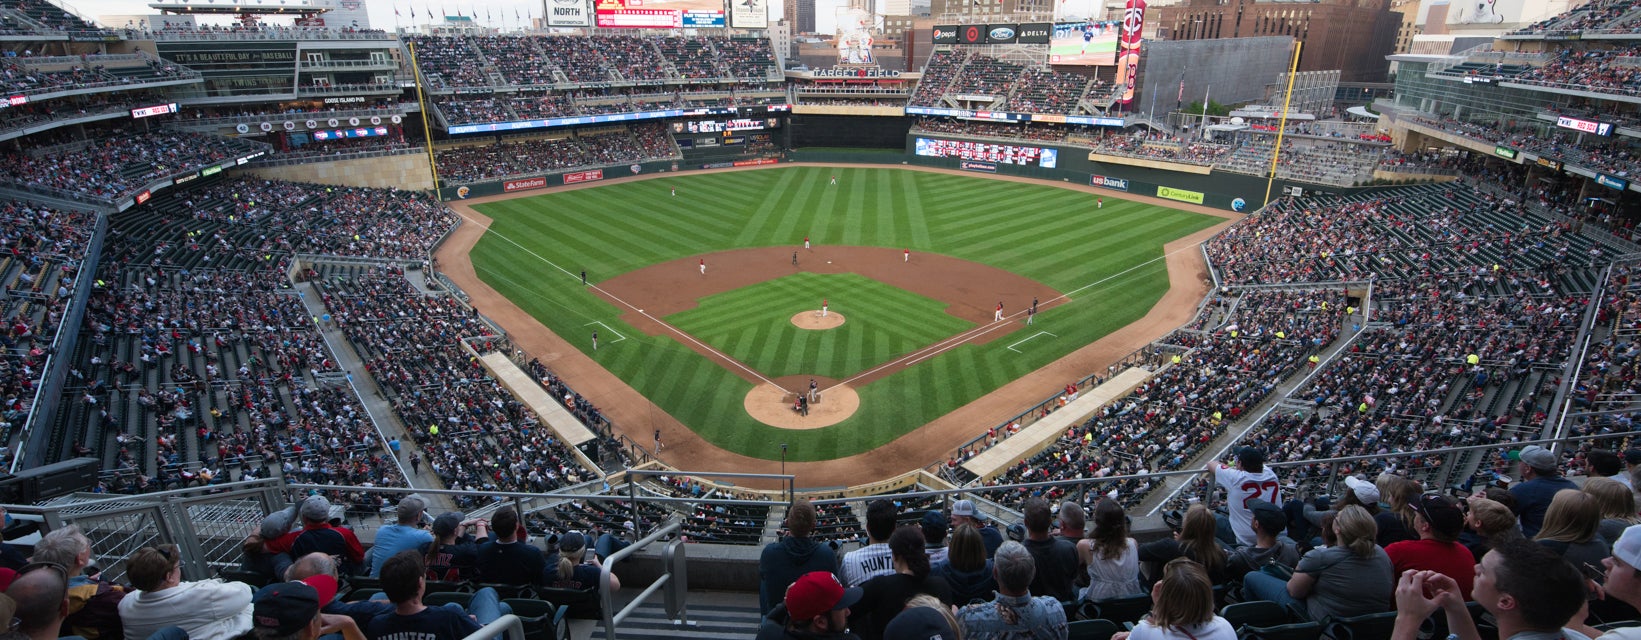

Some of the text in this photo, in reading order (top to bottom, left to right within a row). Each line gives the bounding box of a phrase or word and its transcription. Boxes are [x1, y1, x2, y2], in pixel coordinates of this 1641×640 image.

[554, 7, 580, 16] NORTH
[941, 30, 956, 38] pepsi
[814, 69, 900, 77] TARGET FIELD
[1170, 191, 1199, 200] CenturyLink
[1241, 481, 1278, 509] 27
